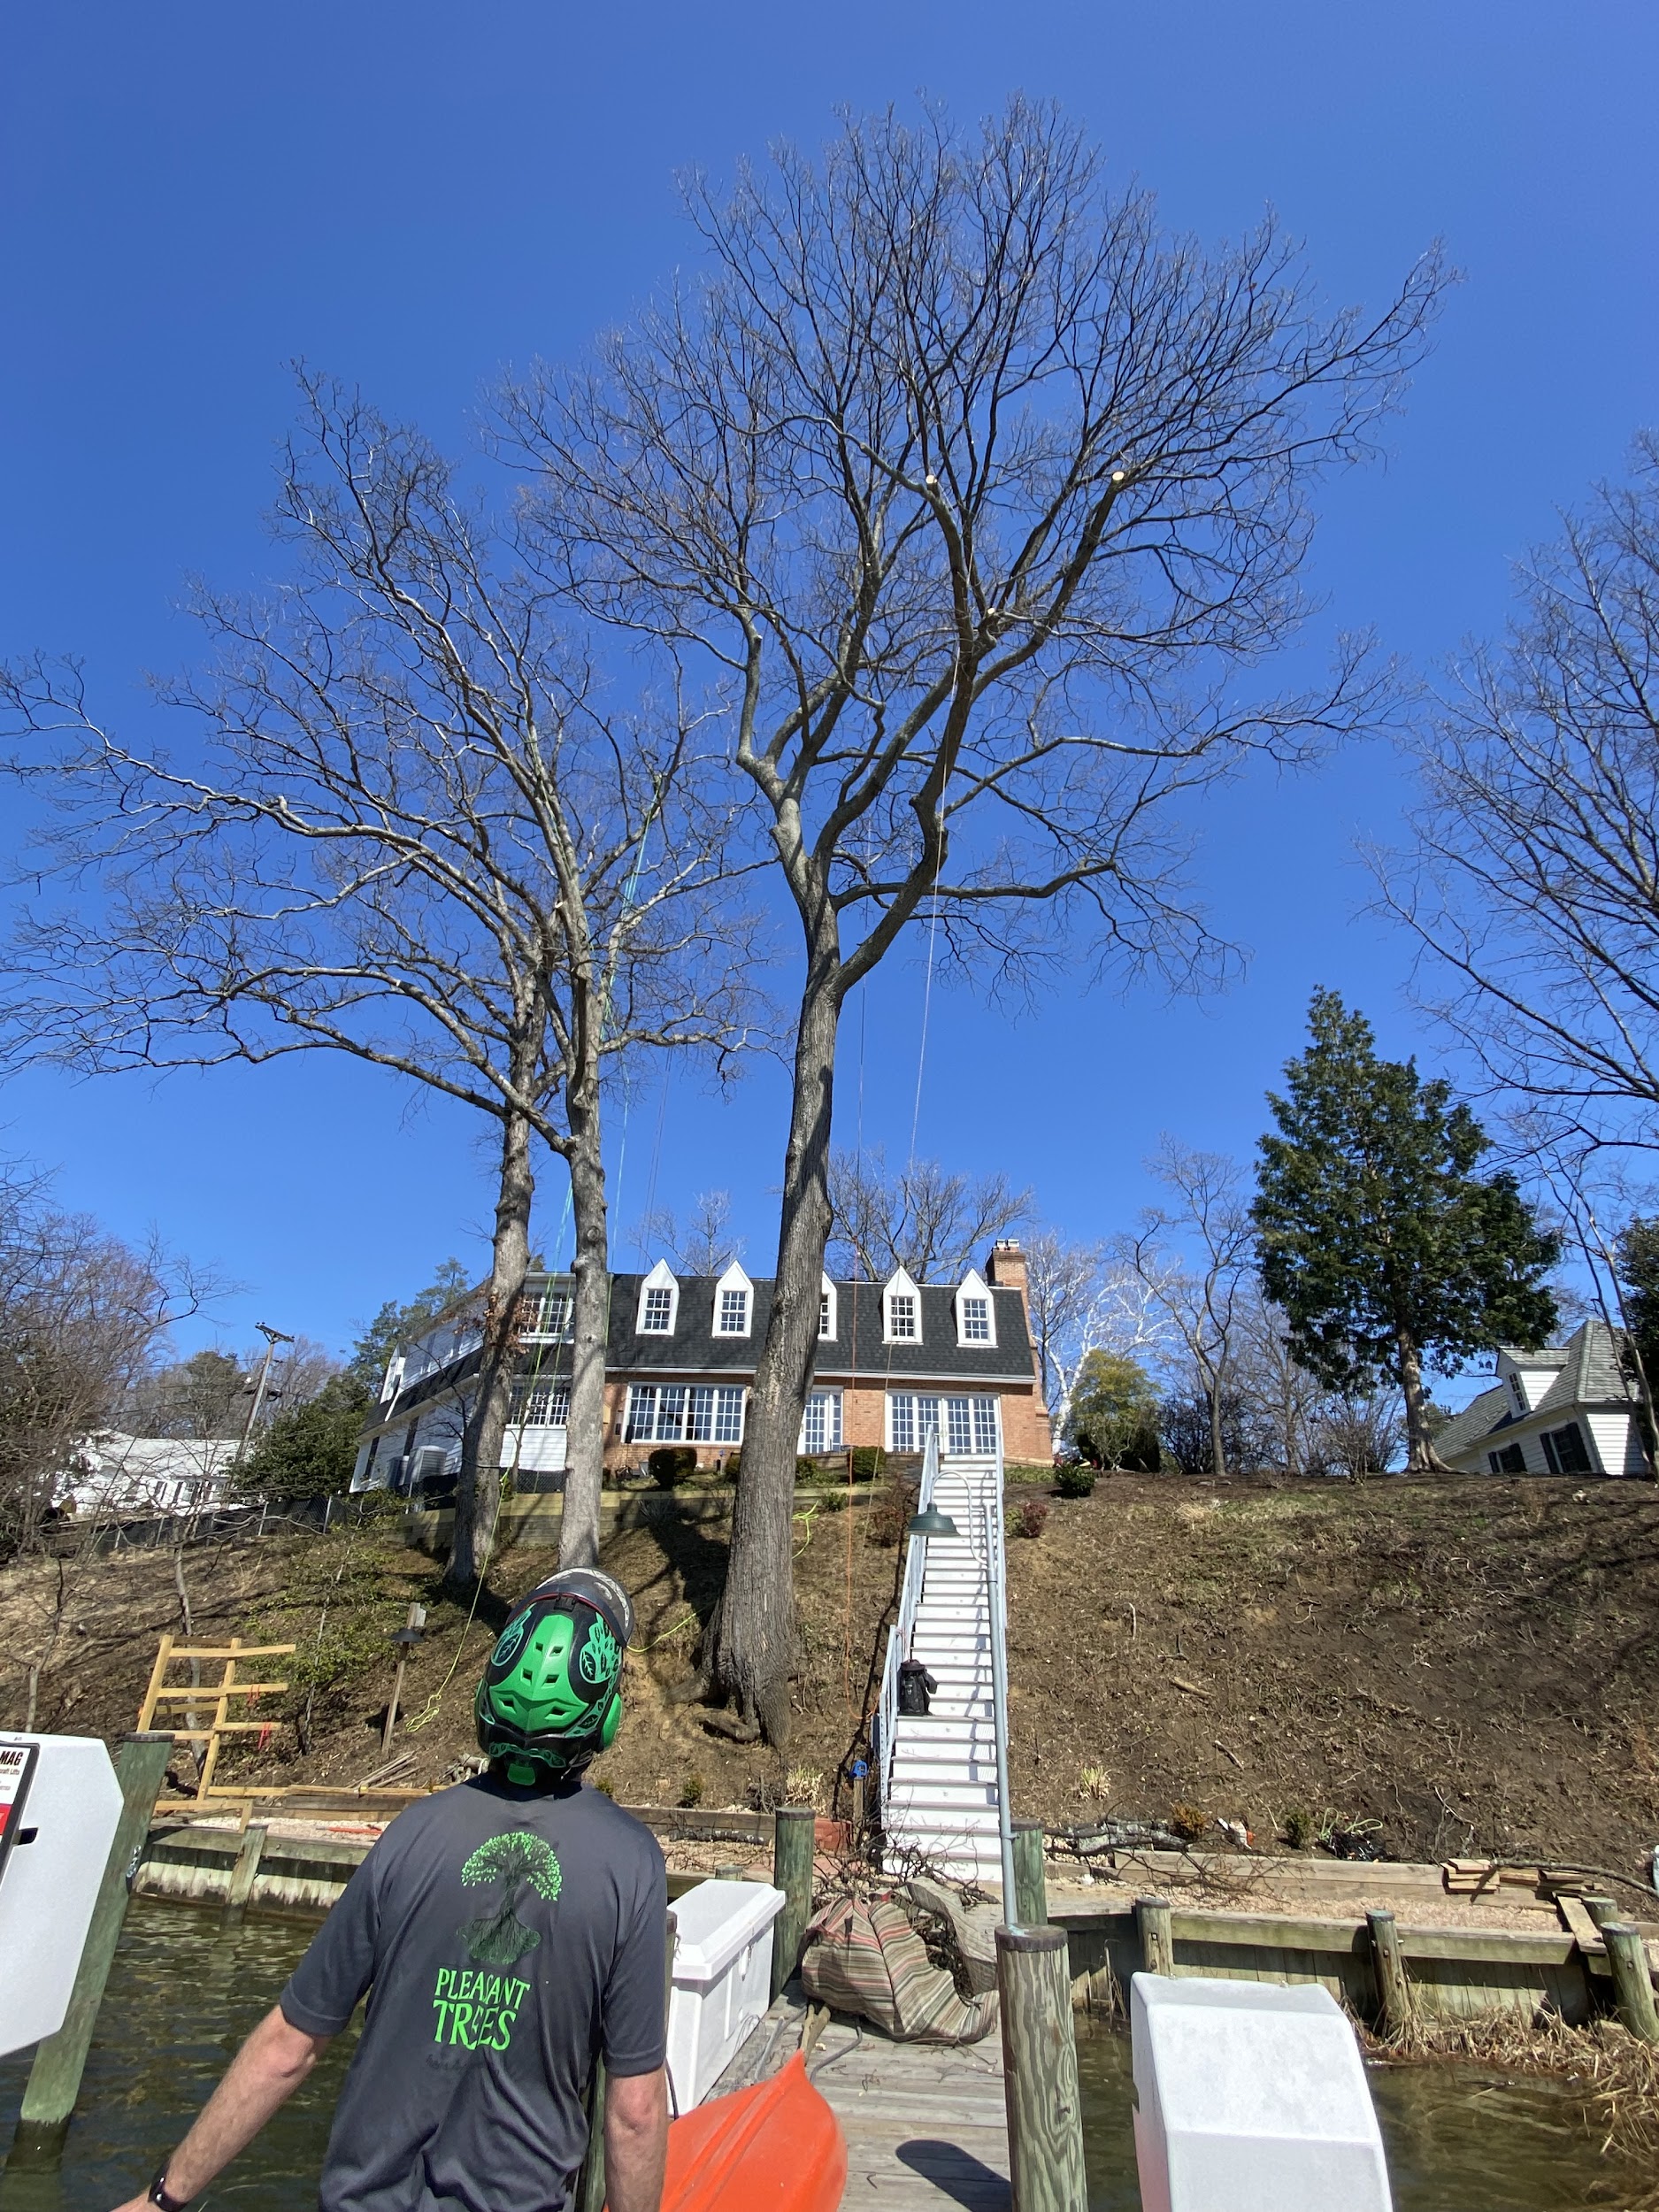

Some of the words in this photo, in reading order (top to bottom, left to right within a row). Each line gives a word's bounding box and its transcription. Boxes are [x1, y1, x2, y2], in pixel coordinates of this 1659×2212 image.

[0, 1750, 24, 1766] MAG
[434, 1968, 531, 2010] PLEASANT
[433, 1999, 517, 2051] TREES
